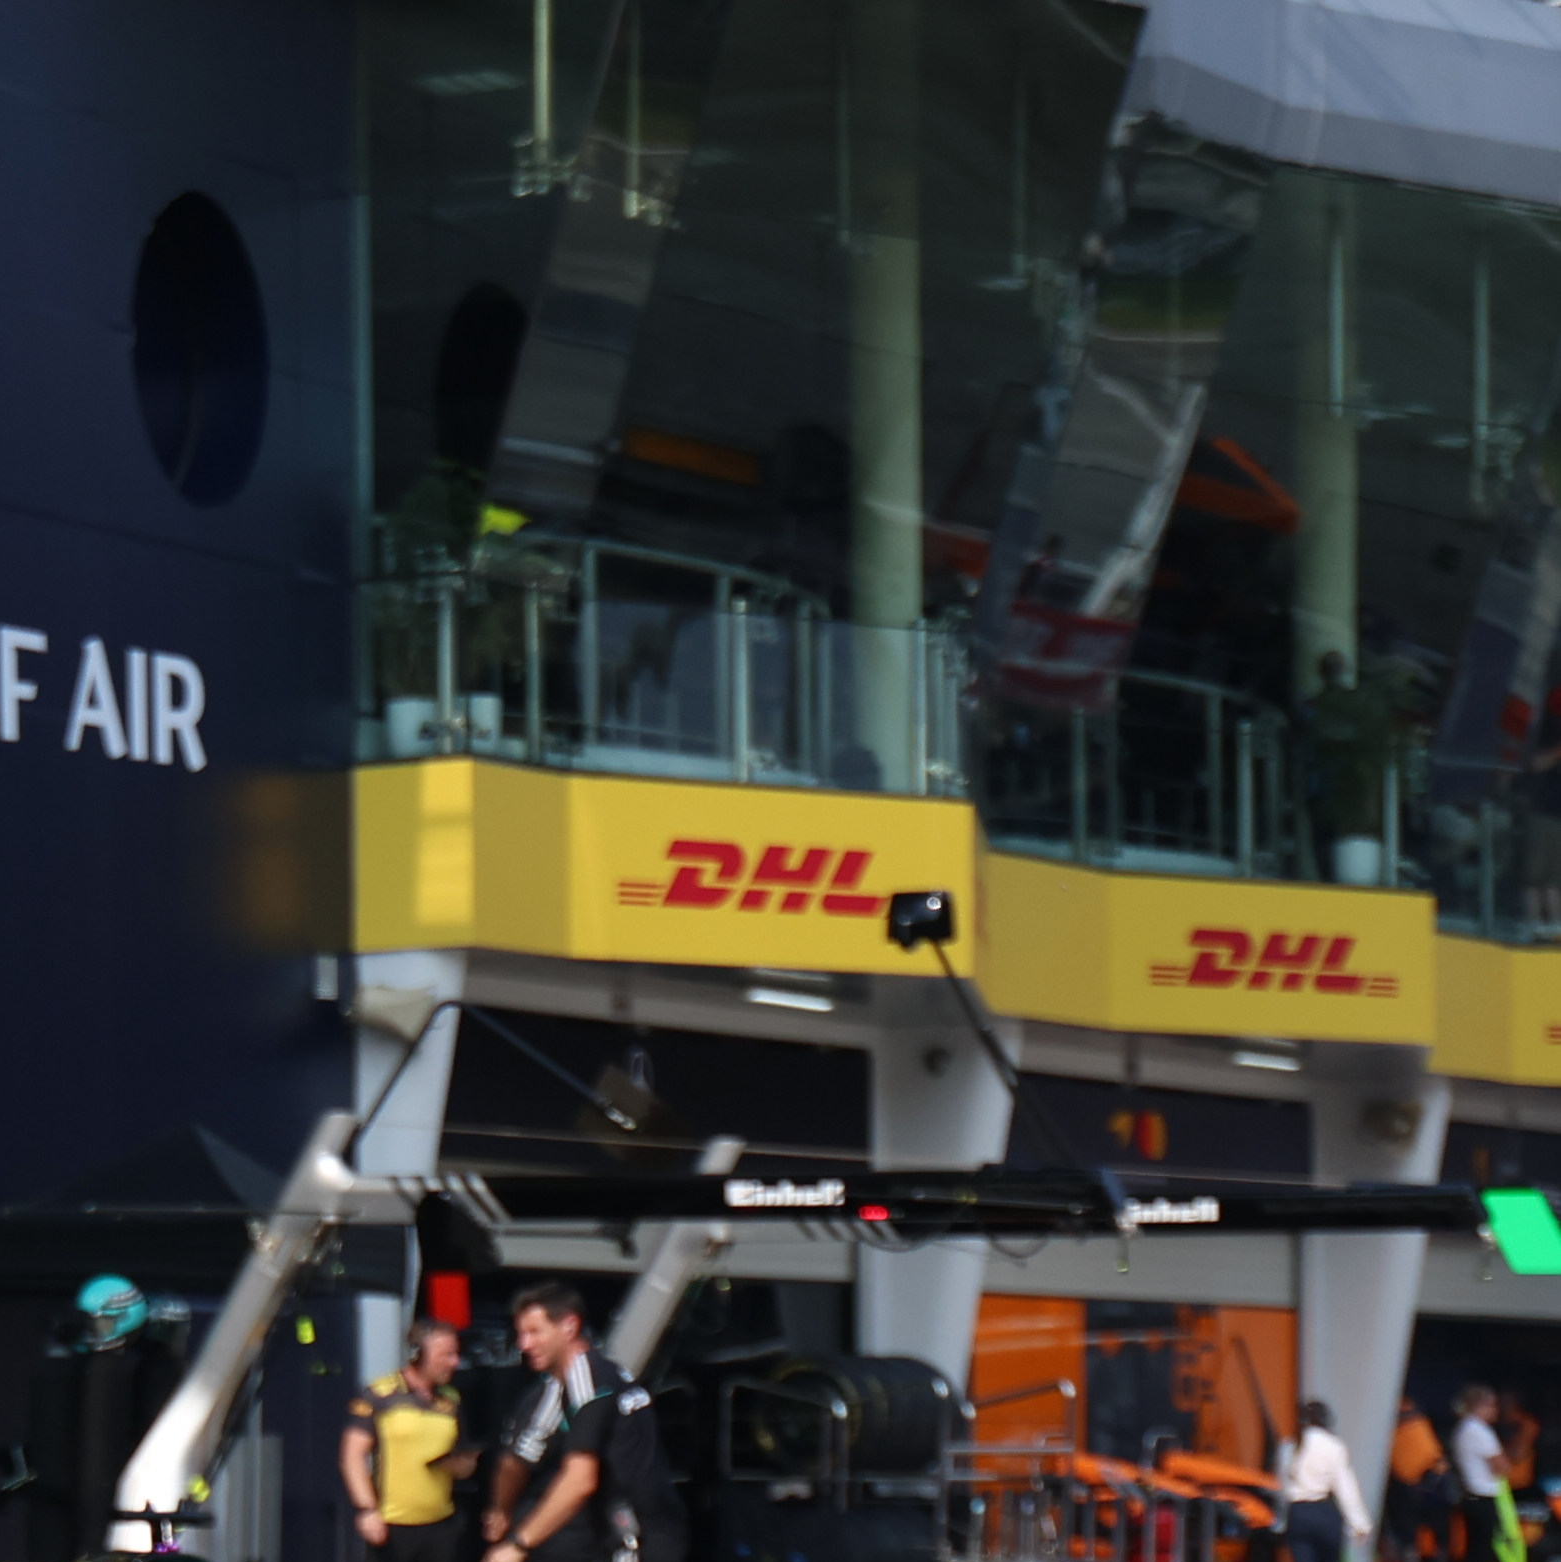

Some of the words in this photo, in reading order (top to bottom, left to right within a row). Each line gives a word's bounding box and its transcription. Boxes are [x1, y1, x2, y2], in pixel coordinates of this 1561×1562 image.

[64, 636, 207, 772] AIR
[661, 839, 891, 916] DHL
[1186, 929, 1367, 996] DHL
